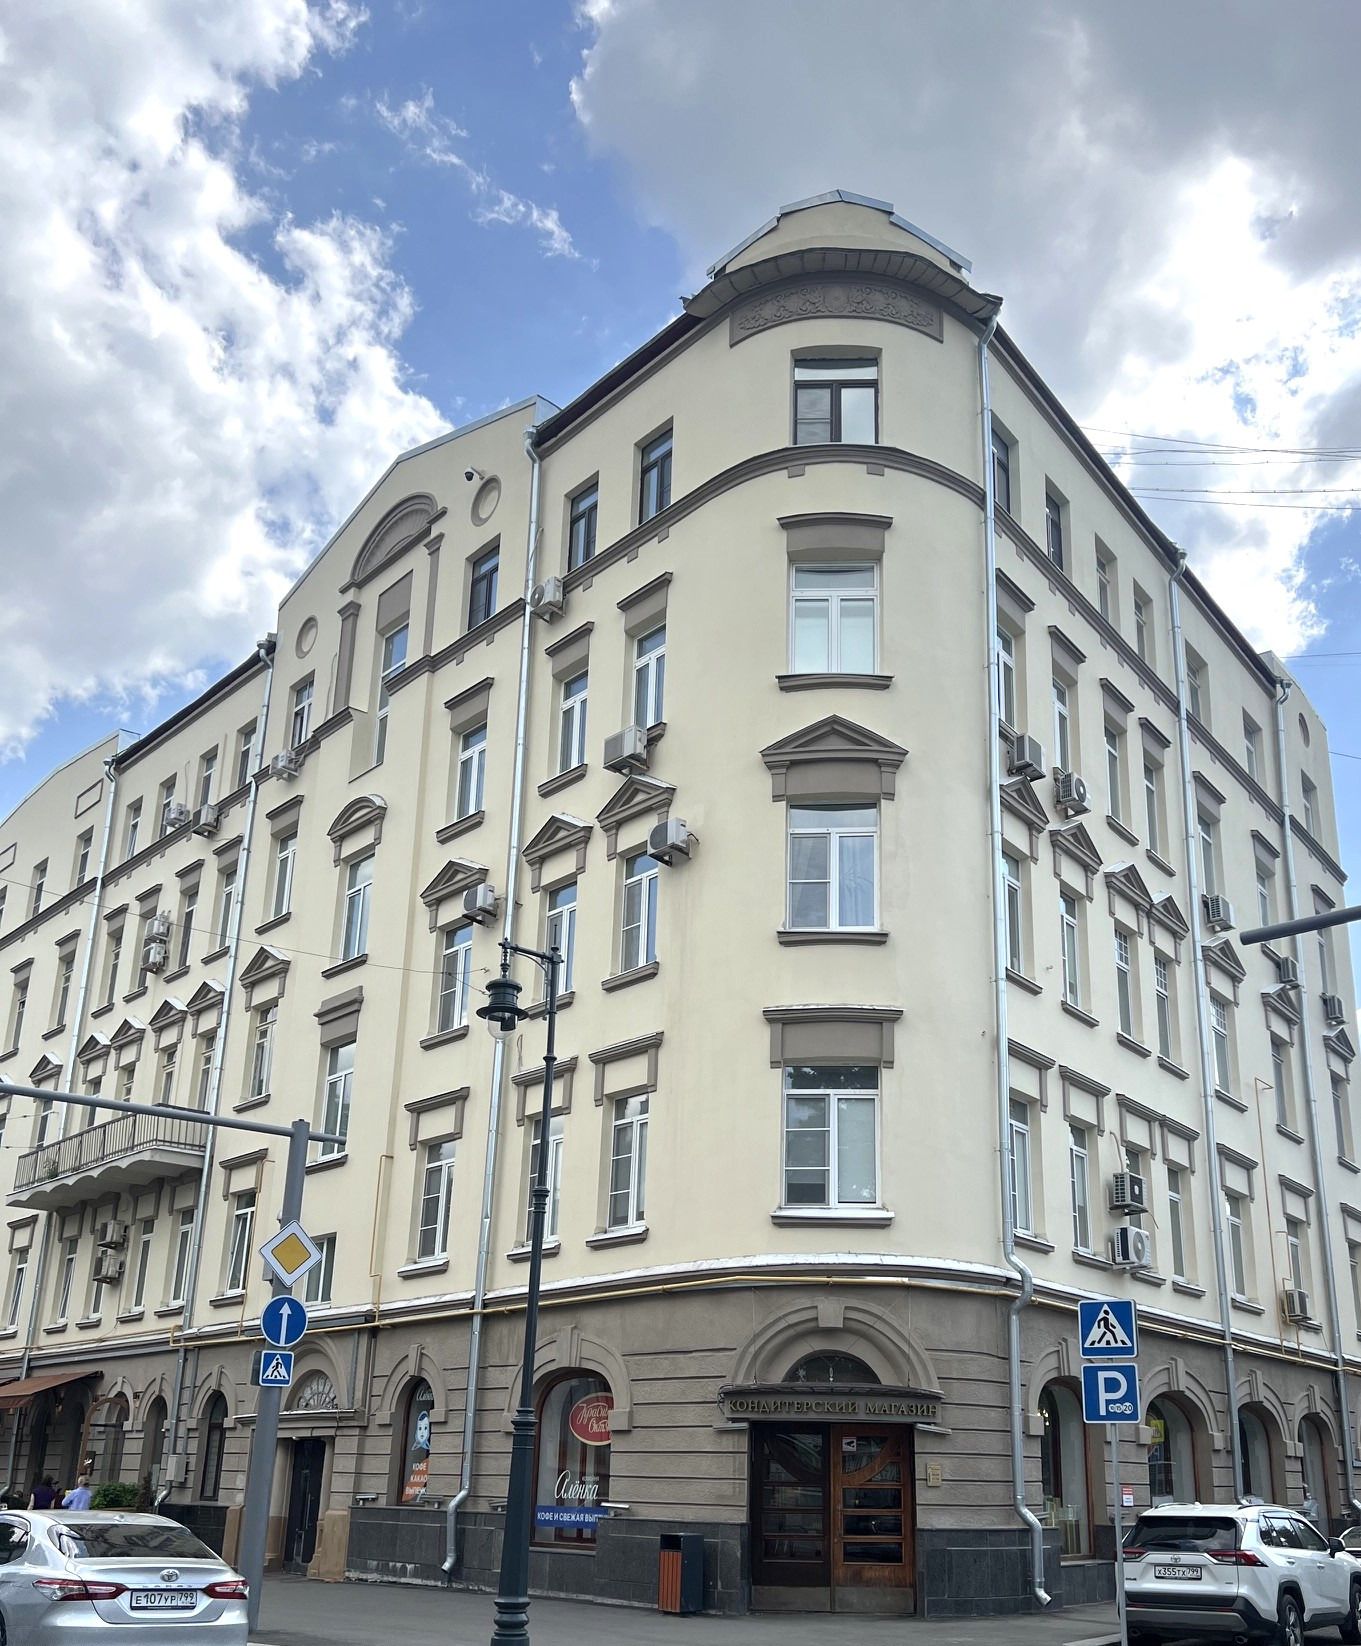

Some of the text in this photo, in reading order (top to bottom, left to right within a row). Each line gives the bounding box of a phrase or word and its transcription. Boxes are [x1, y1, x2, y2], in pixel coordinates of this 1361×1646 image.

[1097, 1371, 1127, 1415] P
[728, 1399, 938, 1416] КОНДИТЕРСКИЙ МАГАЗИН
[412, 1462, 427, 1471] КОФЕ
[410, 1474, 428, 1483] КАКАО
[554, 1469, 599, 1500] Алёнка
[537, 1511, 553, 1521] КОФЕ
[553, 1512, 559, 1521] И
[559, 1512, 583, 1522] СВЕЖАЯ
[178, 1592, 195, 1602] 799
